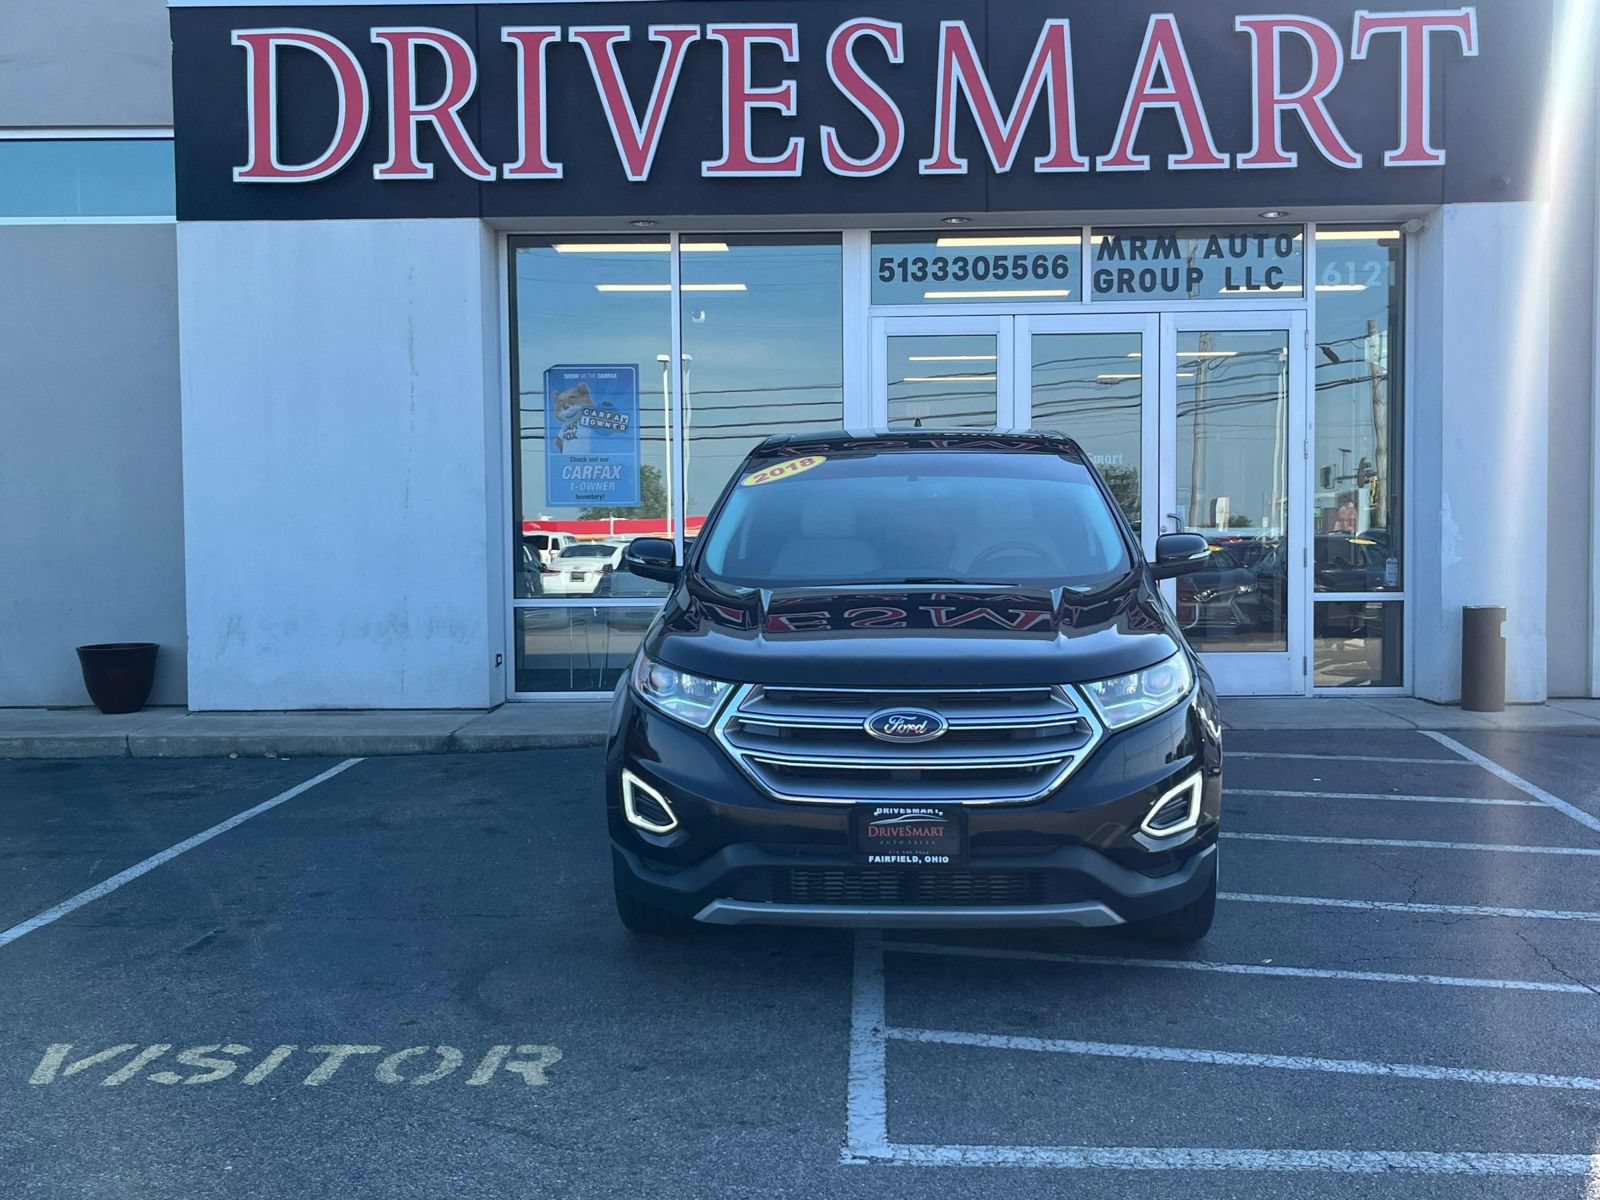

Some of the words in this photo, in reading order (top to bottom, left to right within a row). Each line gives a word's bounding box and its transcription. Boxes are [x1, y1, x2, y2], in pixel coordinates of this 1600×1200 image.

[231, 7, 1479, 183] DRIVESMART
[1097, 234, 1181, 261] MRM
[1203, 233, 1293, 259] AUTO
[878, 254, 1069, 283] 5133305566
[1093, 268, 1203, 294] GROUP
[1225, 266, 1284, 291] LLC
[1321, 261, 1396, 287] 6121
[583, 408, 629, 424] CARFAX
[561, 465, 622, 480] CARFAX
[753, 458, 817, 484] 2018
[569, 481, 616, 491] 1-OWNER
[884, 715, 928, 734] Ford
[868, 855, 922, 864] FAIRFIELD,
[924, 855, 949, 863] OHIO
[27, 1043, 564, 1087] VISITOR
